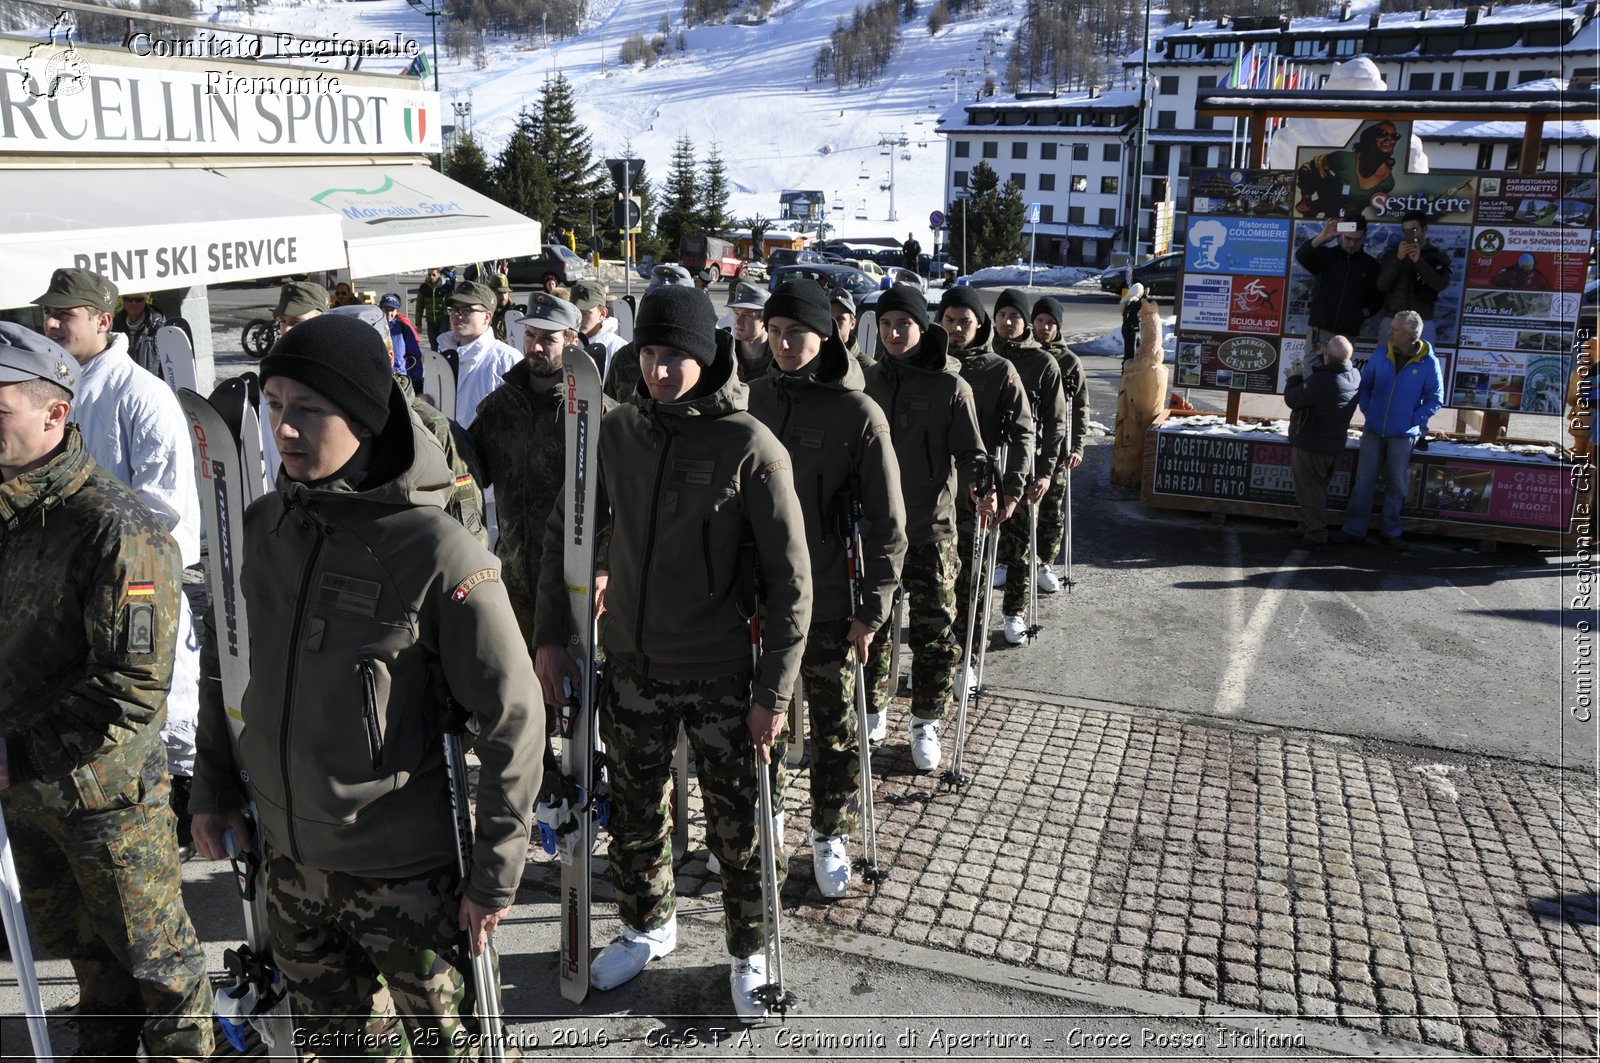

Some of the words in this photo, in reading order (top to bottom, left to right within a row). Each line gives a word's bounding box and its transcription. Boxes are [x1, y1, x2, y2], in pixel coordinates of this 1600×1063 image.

[403, 98, 425, 107] ITALIA
[254, 88, 388, 145] SPORT
[1505, 184, 1558, 192] CHISONETTO
[342, 205, 420, 220] Marcellin
[418, 200, 464, 216] Sport
[1371, 192, 1471, 216] Sestriere
[1386, 210, 1405, 218] high
[1239, 221, 1280, 230] Ristorante
[1229, 228, 1288, 238] COLOMBIERE
[1508, 228, 1536, 237] Scuola
[1537, 229, 1579, 238] Nazionale
[1507, 237, 1522, 245] SCI
[1529, 238, 1588, 247] SNOWBOARD
[155, 245, 198, 279] SKI
[207, 236, 298, 273] SERVICE
[1473, 306, 1497, 314] Barba
[1499, 307, 1513, 315] Sel
[1230, 317, 1263, 326] SCUOLA
[1264, 319, 1279, 327] SCI
[1231, 339, 1266, 349] ALBERGO
[1225, 355, 1267, 369] CENTRO
[566, 374, 577, 415] PRO
[193, 424, 213, 480] PRO
[1159, 435, 1249, 461] PROGETTAZIONE
[1157, 455, 1248, 477] ristrutturazioni
[1156, 473, 1246, 496] ARREDAMENTO
[1514, 471, 1559, 486] CASE
[1507, 490, 1558, 504] HOTEL
[1512, 501, 1551, 513] NEGOZI
[1499, 509, 1560, 522] WELLNESS
[463, 570, 497, 591] SUISSE
